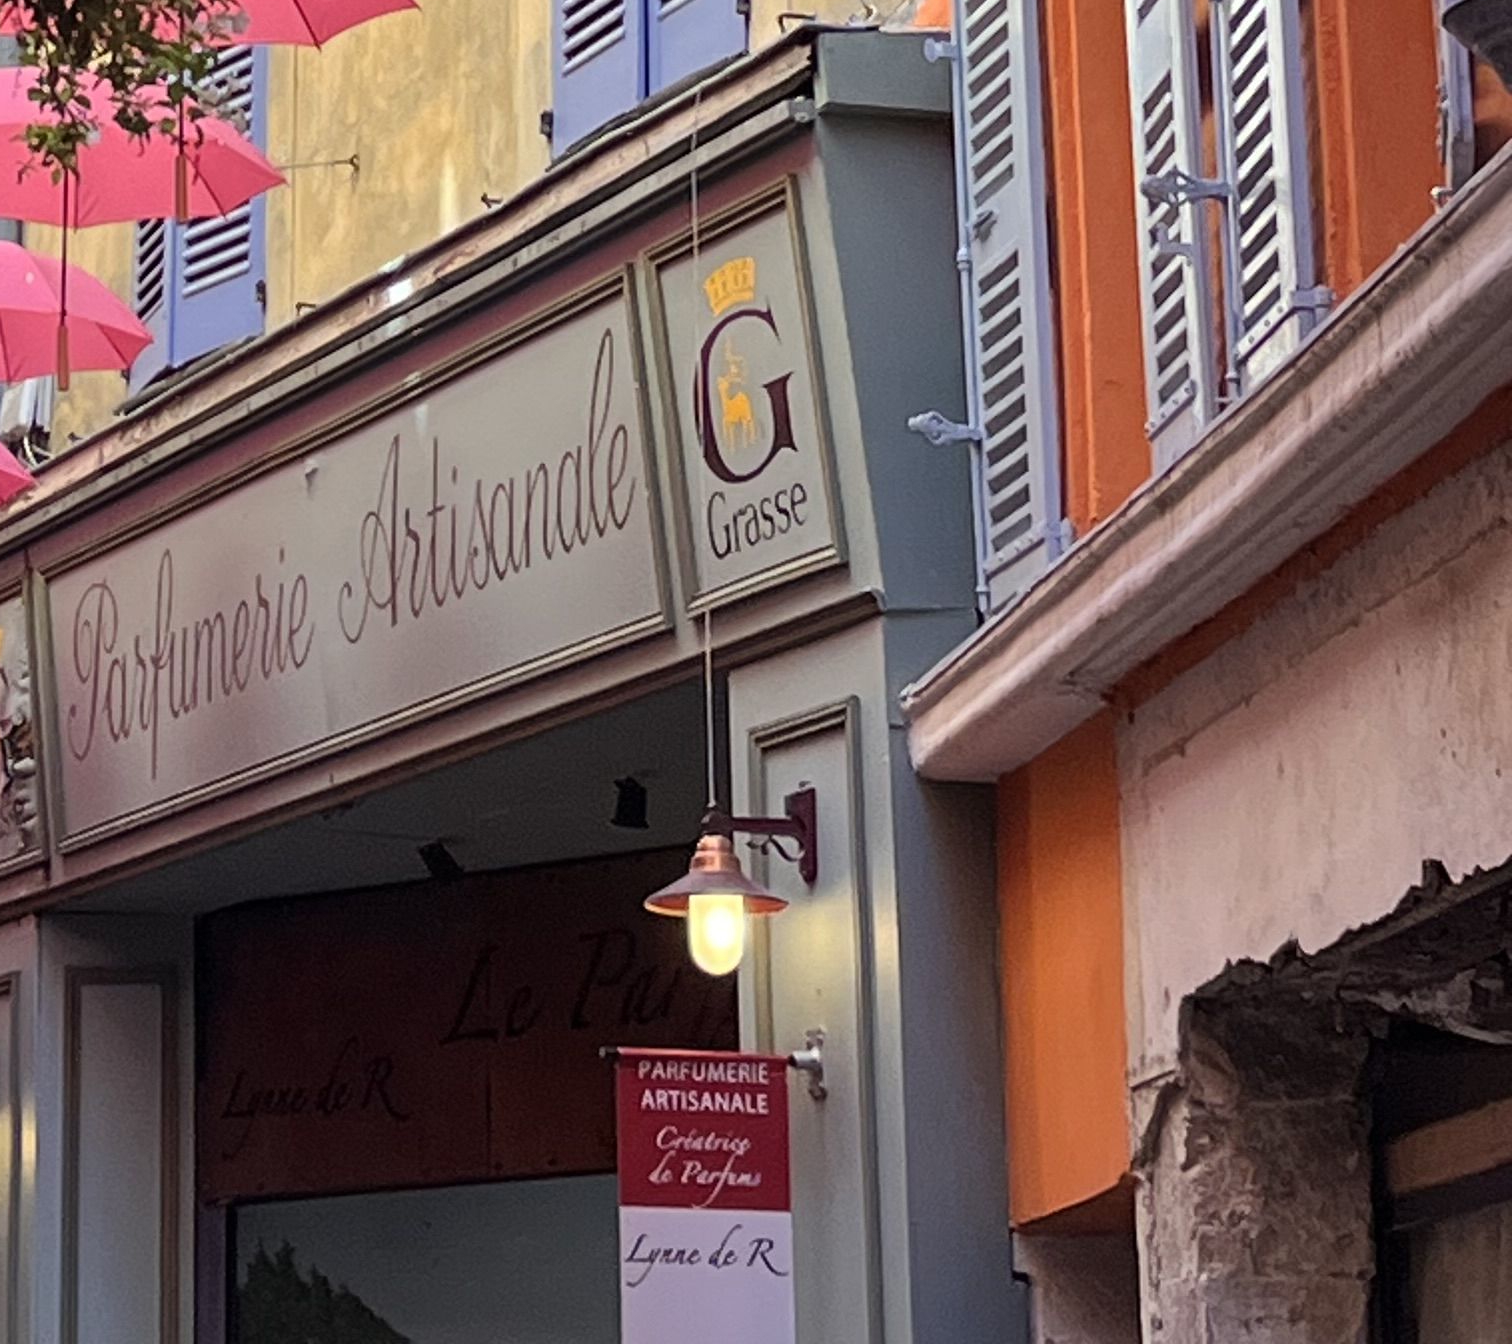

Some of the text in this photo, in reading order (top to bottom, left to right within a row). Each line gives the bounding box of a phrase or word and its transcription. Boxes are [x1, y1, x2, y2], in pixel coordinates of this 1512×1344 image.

[693, 295, 799, 484] G
[67, 327, 638, 780] Parfumerie Artisanale
[707, 482, 808, 560] Grasse
[362, 1058, 411, 1123] R
[637, 1059, 771, 1086] PARFUMERIE
[640, 1088, 770, 1116] ARTISANALE
[655, 1125, 752, 1157] Créatrice
[648, 1150, 763, 1209] de Parfums
[624, 1223, 789, 1288] Lynne de R
